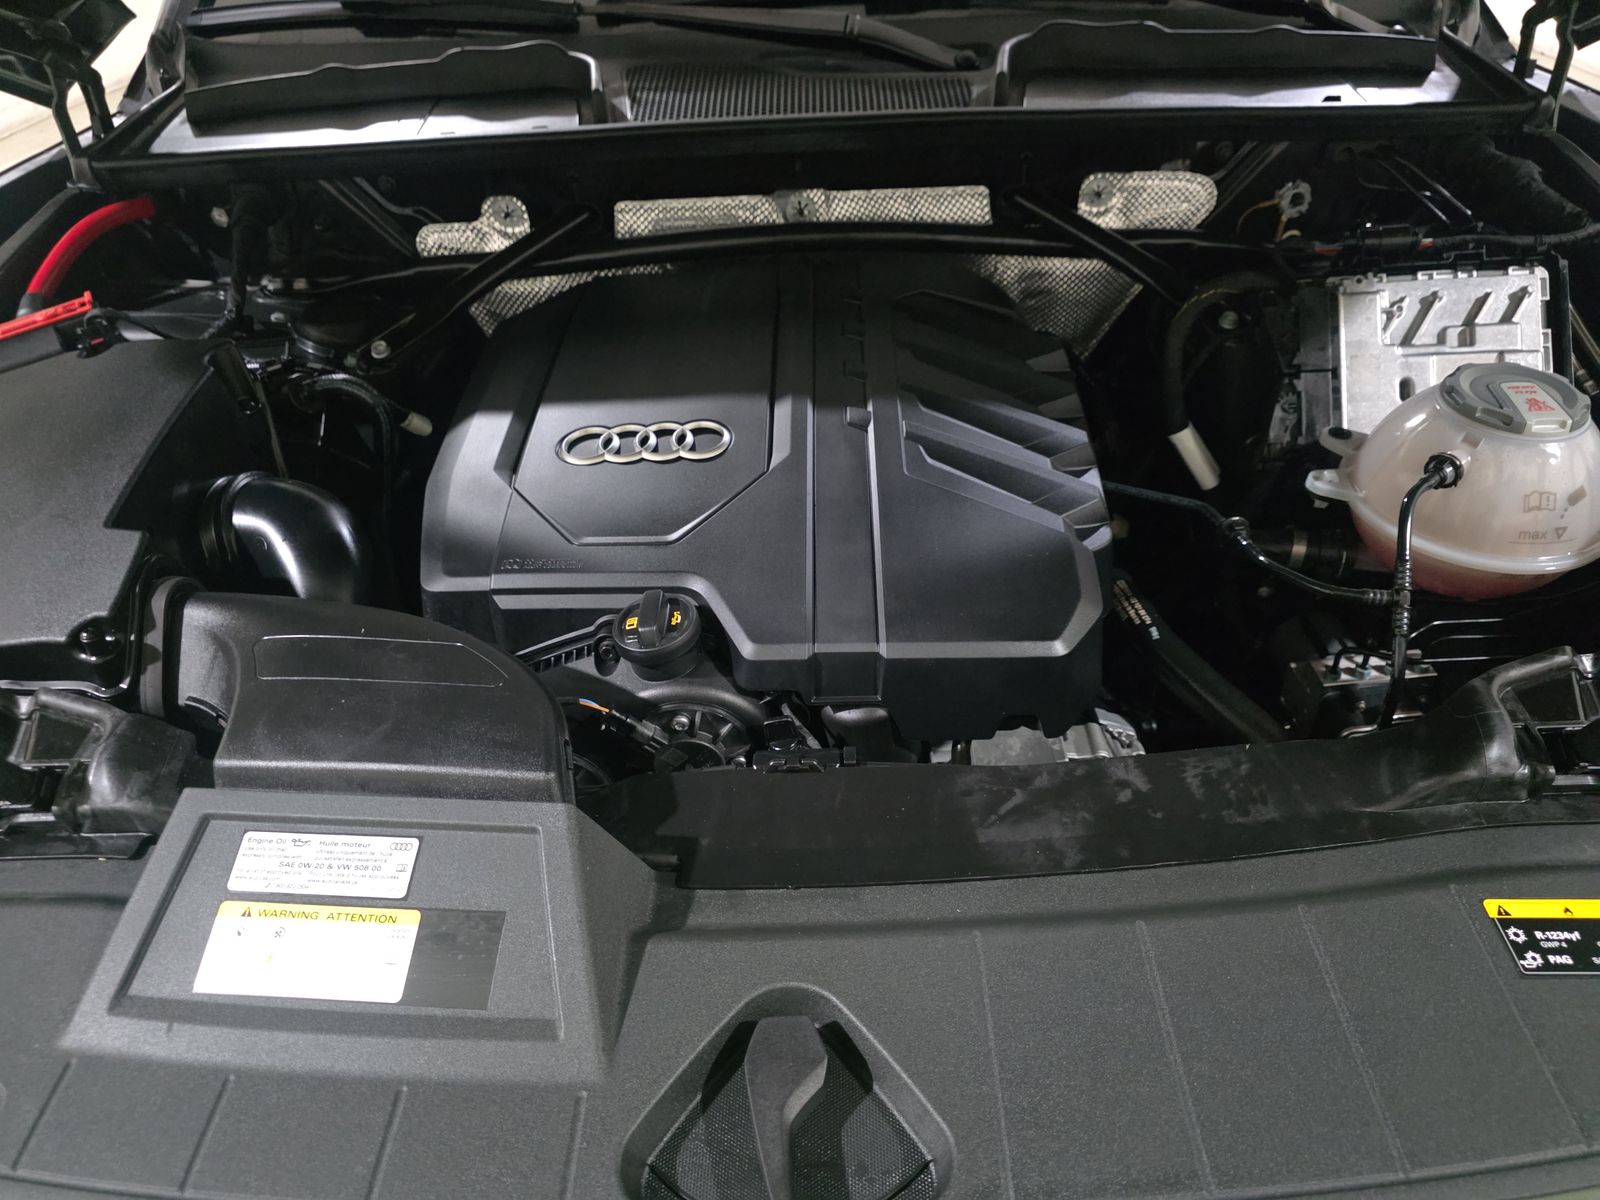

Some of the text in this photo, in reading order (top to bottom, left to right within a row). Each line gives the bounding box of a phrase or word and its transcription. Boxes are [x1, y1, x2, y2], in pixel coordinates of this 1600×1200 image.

[1518, 530, 1548, 540] max
[247, 836, 287, 845] Engine Oil
[336, 863, 353, 871] VW
[354, 864, 370, 872] 508
[257, 908, 398, 925] WARNING ATTENTION
[1533, 930, 1582, 942] R-1234yf
[1547, 954, 1575, 965] PAG
